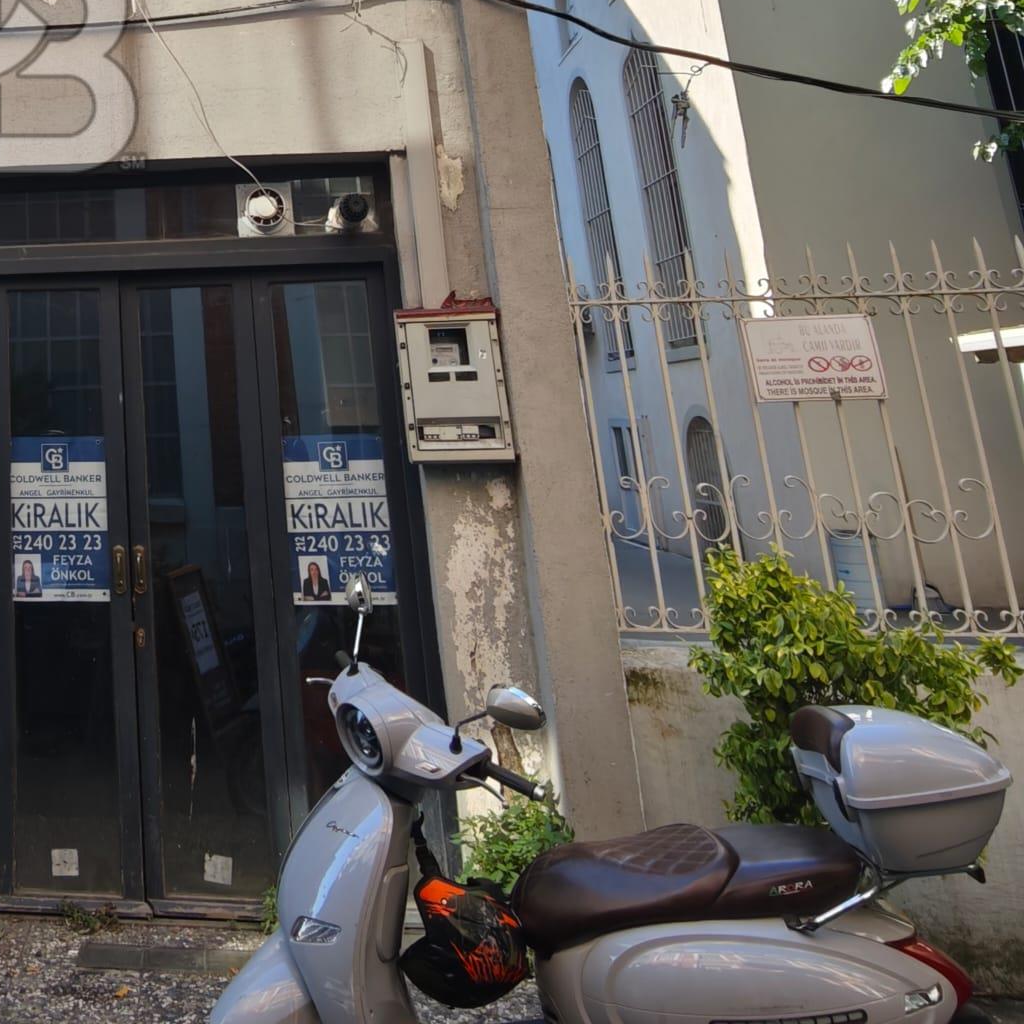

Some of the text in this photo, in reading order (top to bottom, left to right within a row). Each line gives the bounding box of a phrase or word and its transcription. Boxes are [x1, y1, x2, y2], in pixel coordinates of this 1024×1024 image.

[10, 474, 102, 483] COLDWELL BANKER
[286, 472, 385, 483] COLDWELL BANKER
[298, 489, 323, 497] ANGEL
[13, 534, 102, 551] 212 240 23 23
[294, 536, 306, 552] 212
[307, 535, 339, 552] 240
[344, 534, 364, 552] 23
[53, 554, 93, 566] FEYZA
[340, 556, 383, 568] FEYZA
[51, 567, 95, 581] ÖNKOL
[769, 879, 814, 896] ARORA
